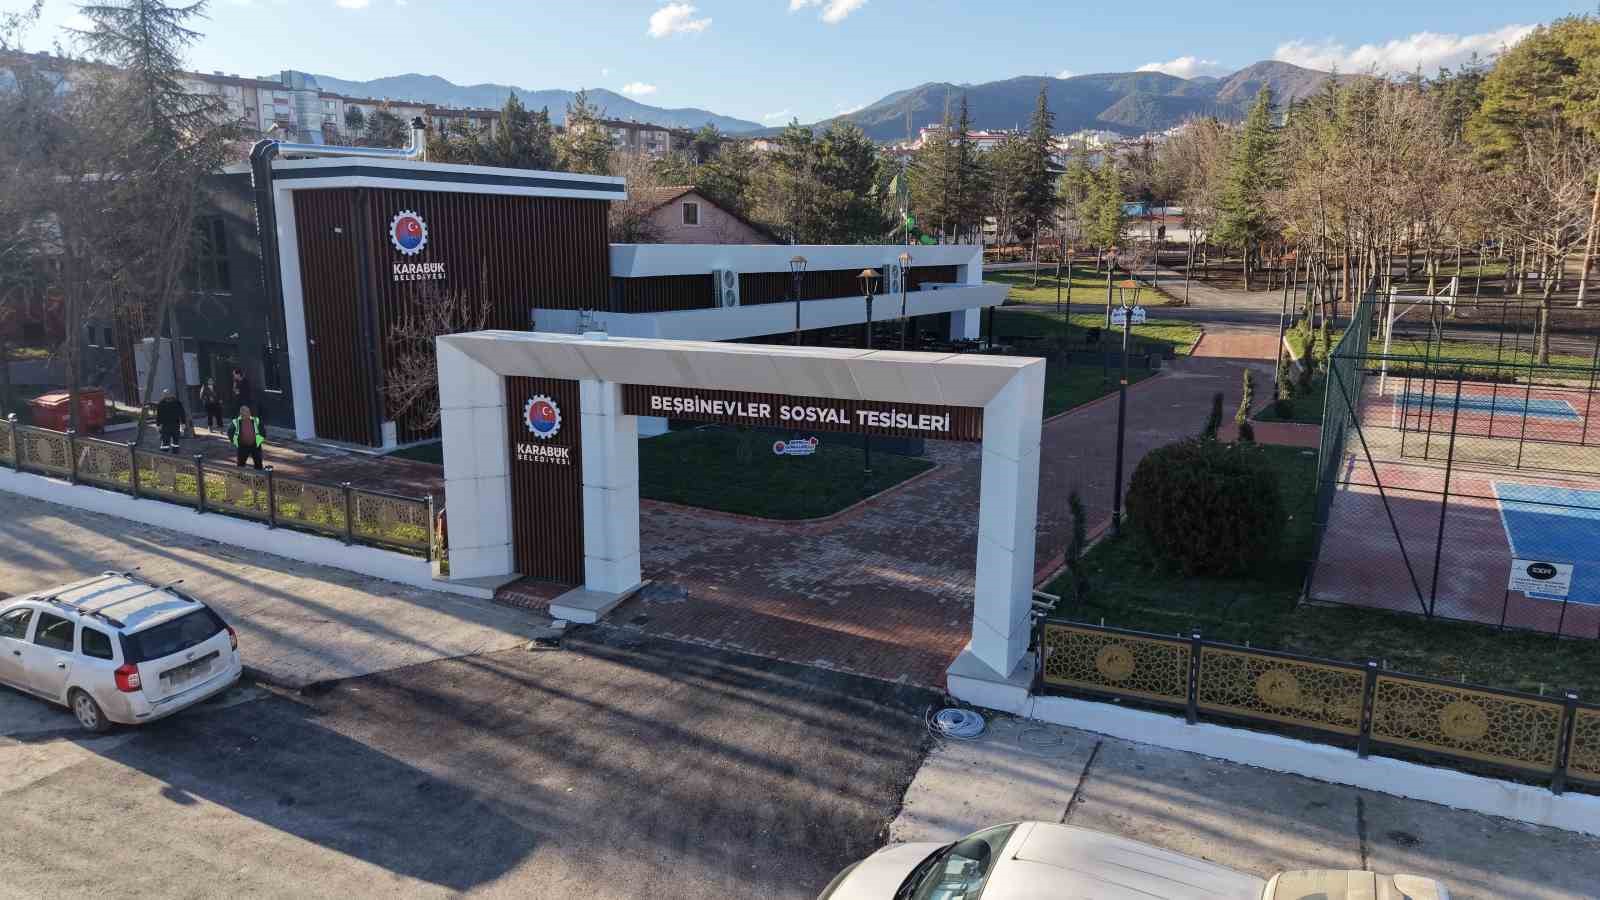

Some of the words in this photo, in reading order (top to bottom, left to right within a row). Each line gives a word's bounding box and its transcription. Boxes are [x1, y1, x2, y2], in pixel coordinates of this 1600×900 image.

[393, 263, 445, 273] KARABÜK
[651, 395, 771, 418] BEŞBİNEVLER
[780, 405, 850, 424] SOSYAL
[856, 408, 950, 432] TESİSLERİ
[517, 443, 569, 458] KARABÜK
